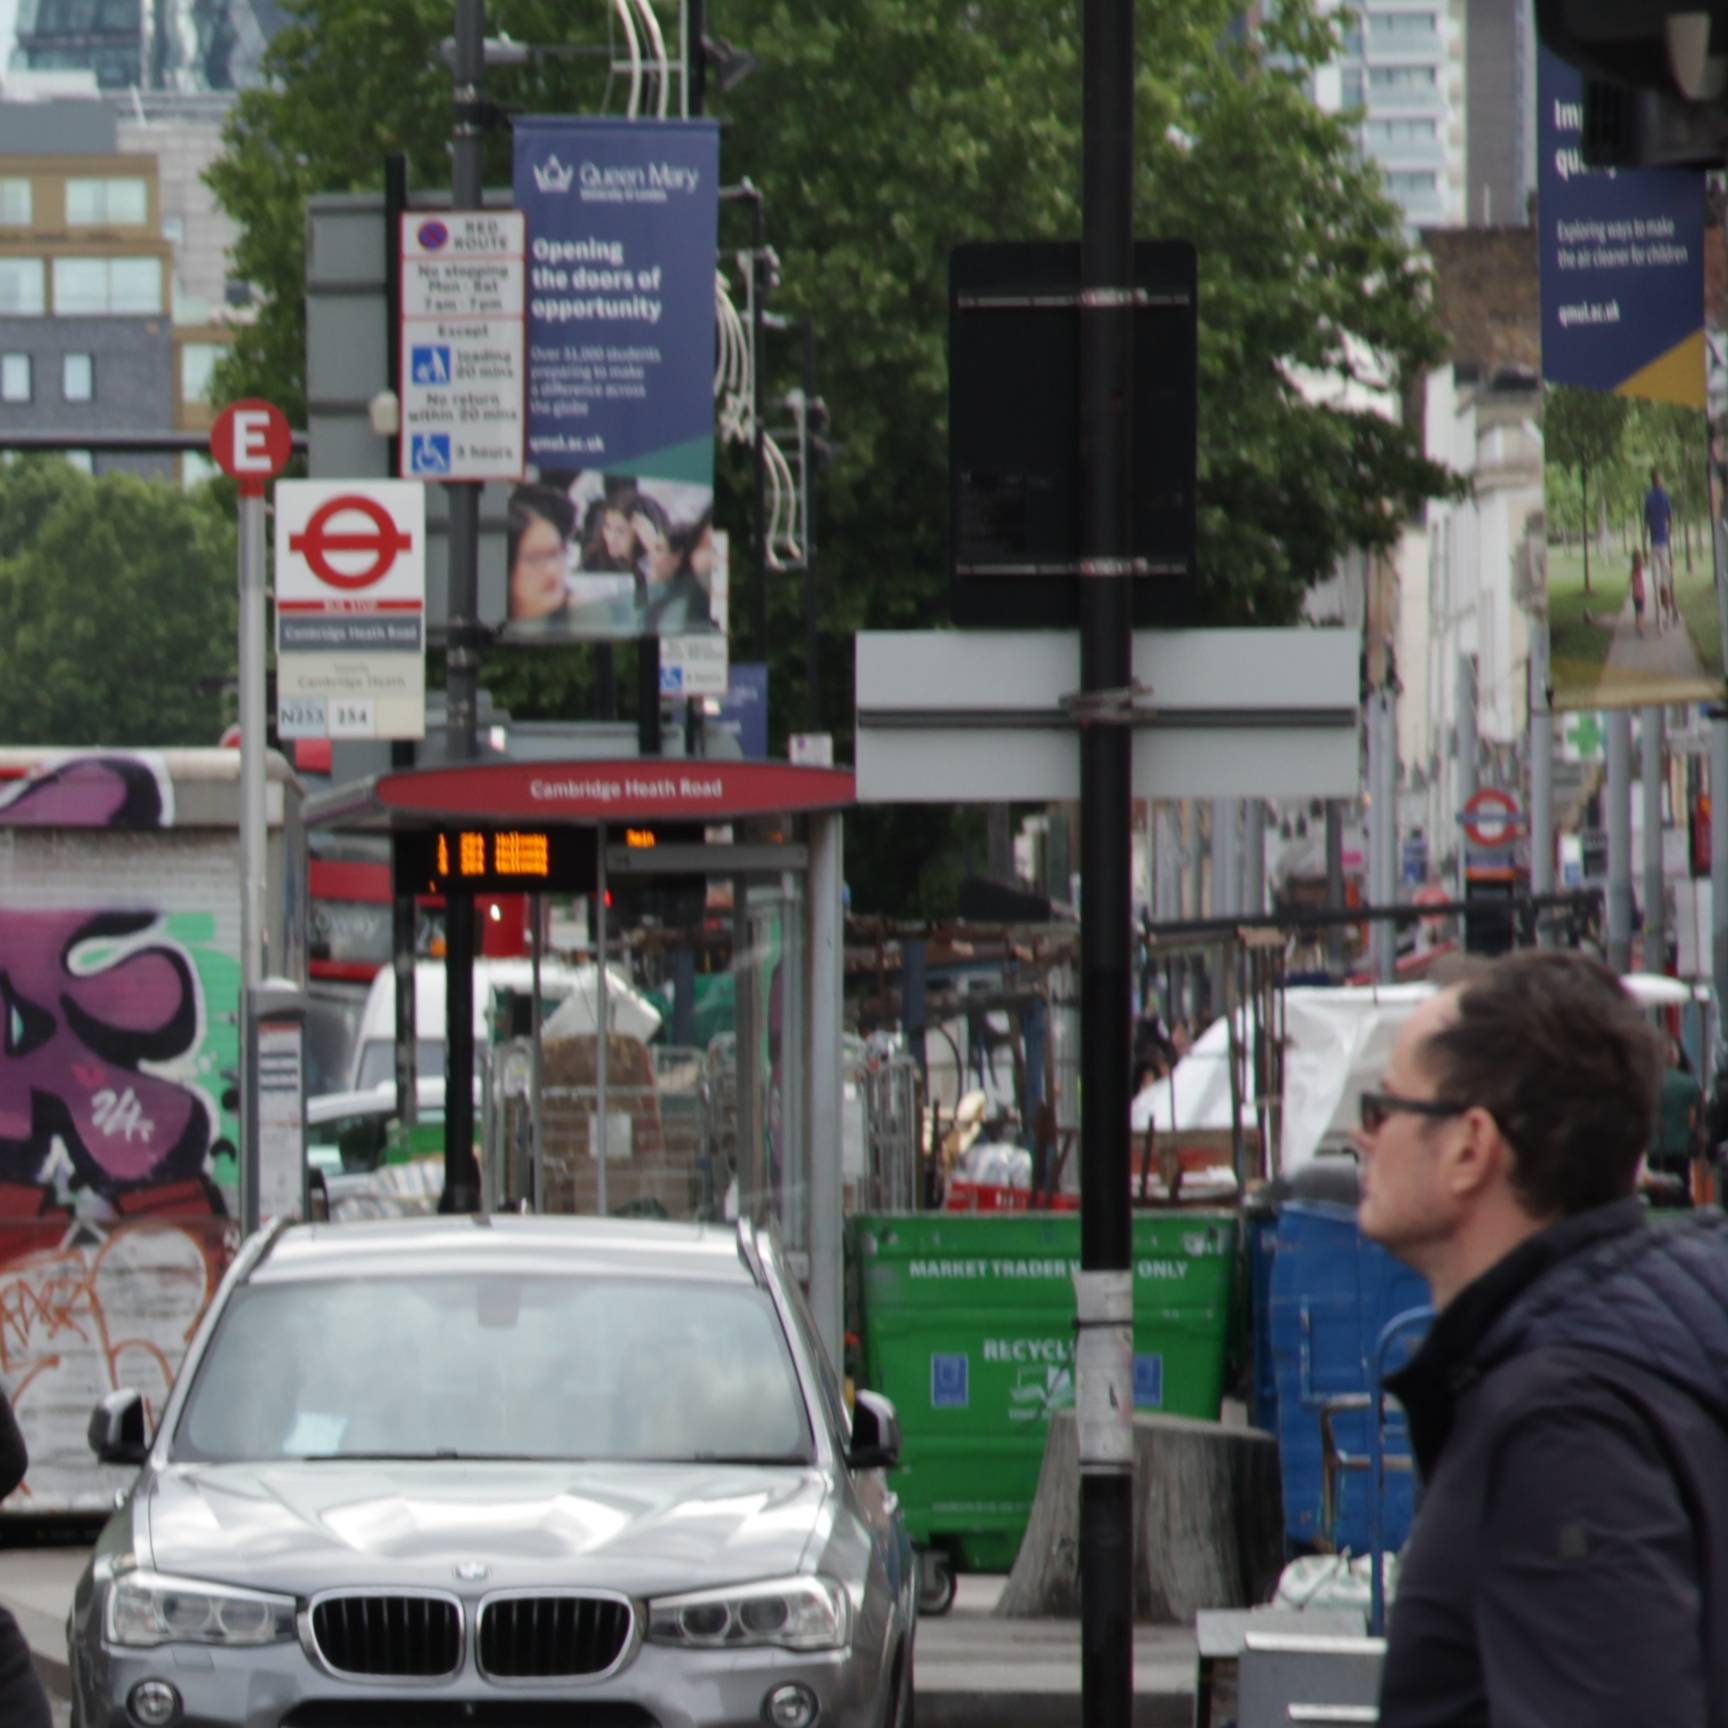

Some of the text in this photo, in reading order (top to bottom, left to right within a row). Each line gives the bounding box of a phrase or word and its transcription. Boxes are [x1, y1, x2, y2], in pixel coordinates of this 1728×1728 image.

[579, 161, 700, 194] Queen Mary
[1557, 220, 1606, 243] Exploring
[1607, 221, 1632, 241] ways
[1645, 215, 1674, 236] make
[532, 236, 624, 266] Opening
[532, 265, 661, 290] the doors of
[531, 295, 662, 325] opportunity
[233, 410, 272, 471] E
[286, 624, 417, 642] Cambridge Heath Road
[530, 777, 723, 802] Cambridge Heath Road
[910, 1259, 988, 1278] MARKET
[993, 1259, 1067, 1279] TRADER
[1138, 1260, 1188, 1279] ONLY
[983, 1339, 1076, 1361] RECYCL
